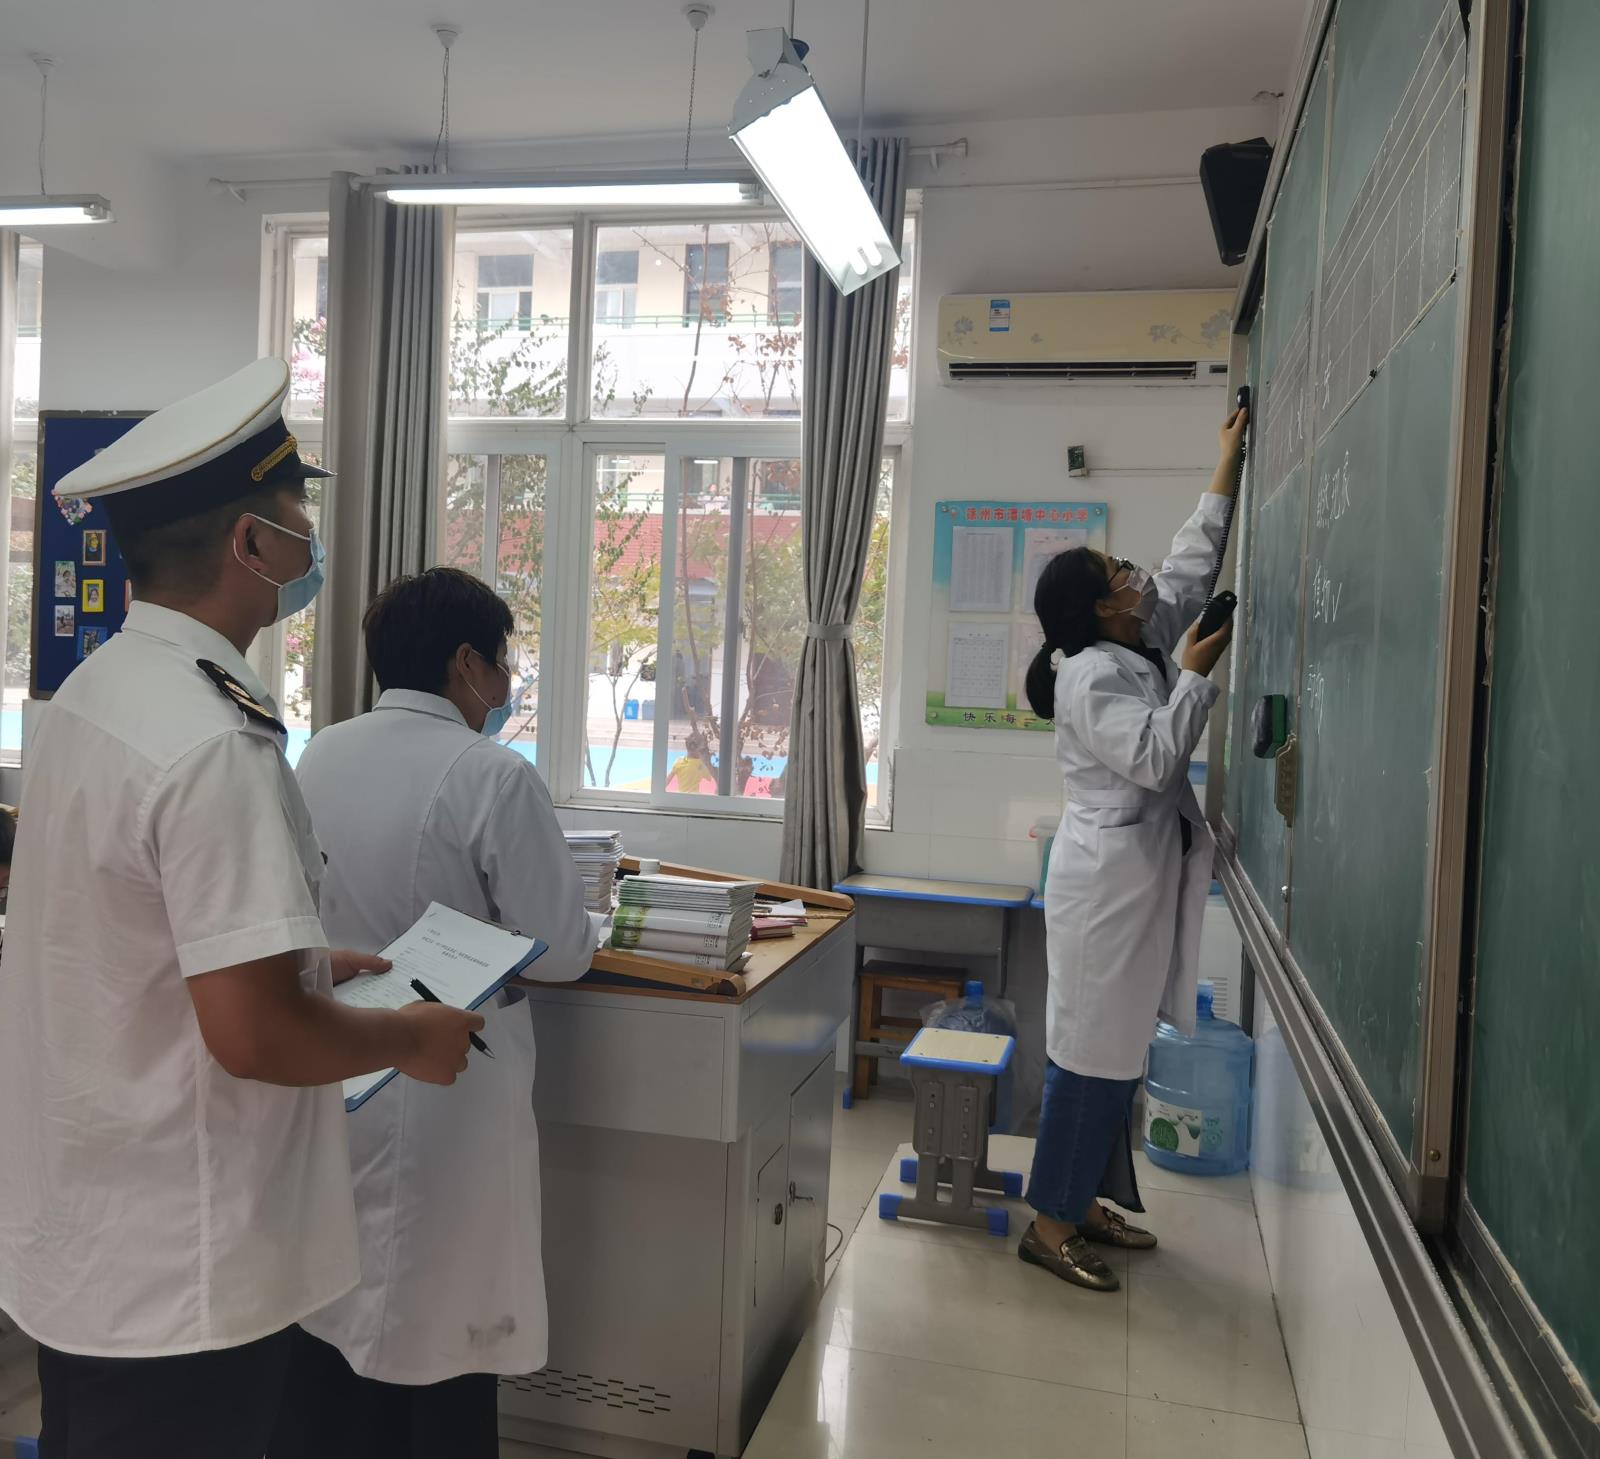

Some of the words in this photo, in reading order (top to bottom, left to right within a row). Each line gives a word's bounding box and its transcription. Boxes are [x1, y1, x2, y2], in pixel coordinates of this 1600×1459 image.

[966, 507, 1088, 521] 州市中心小学
